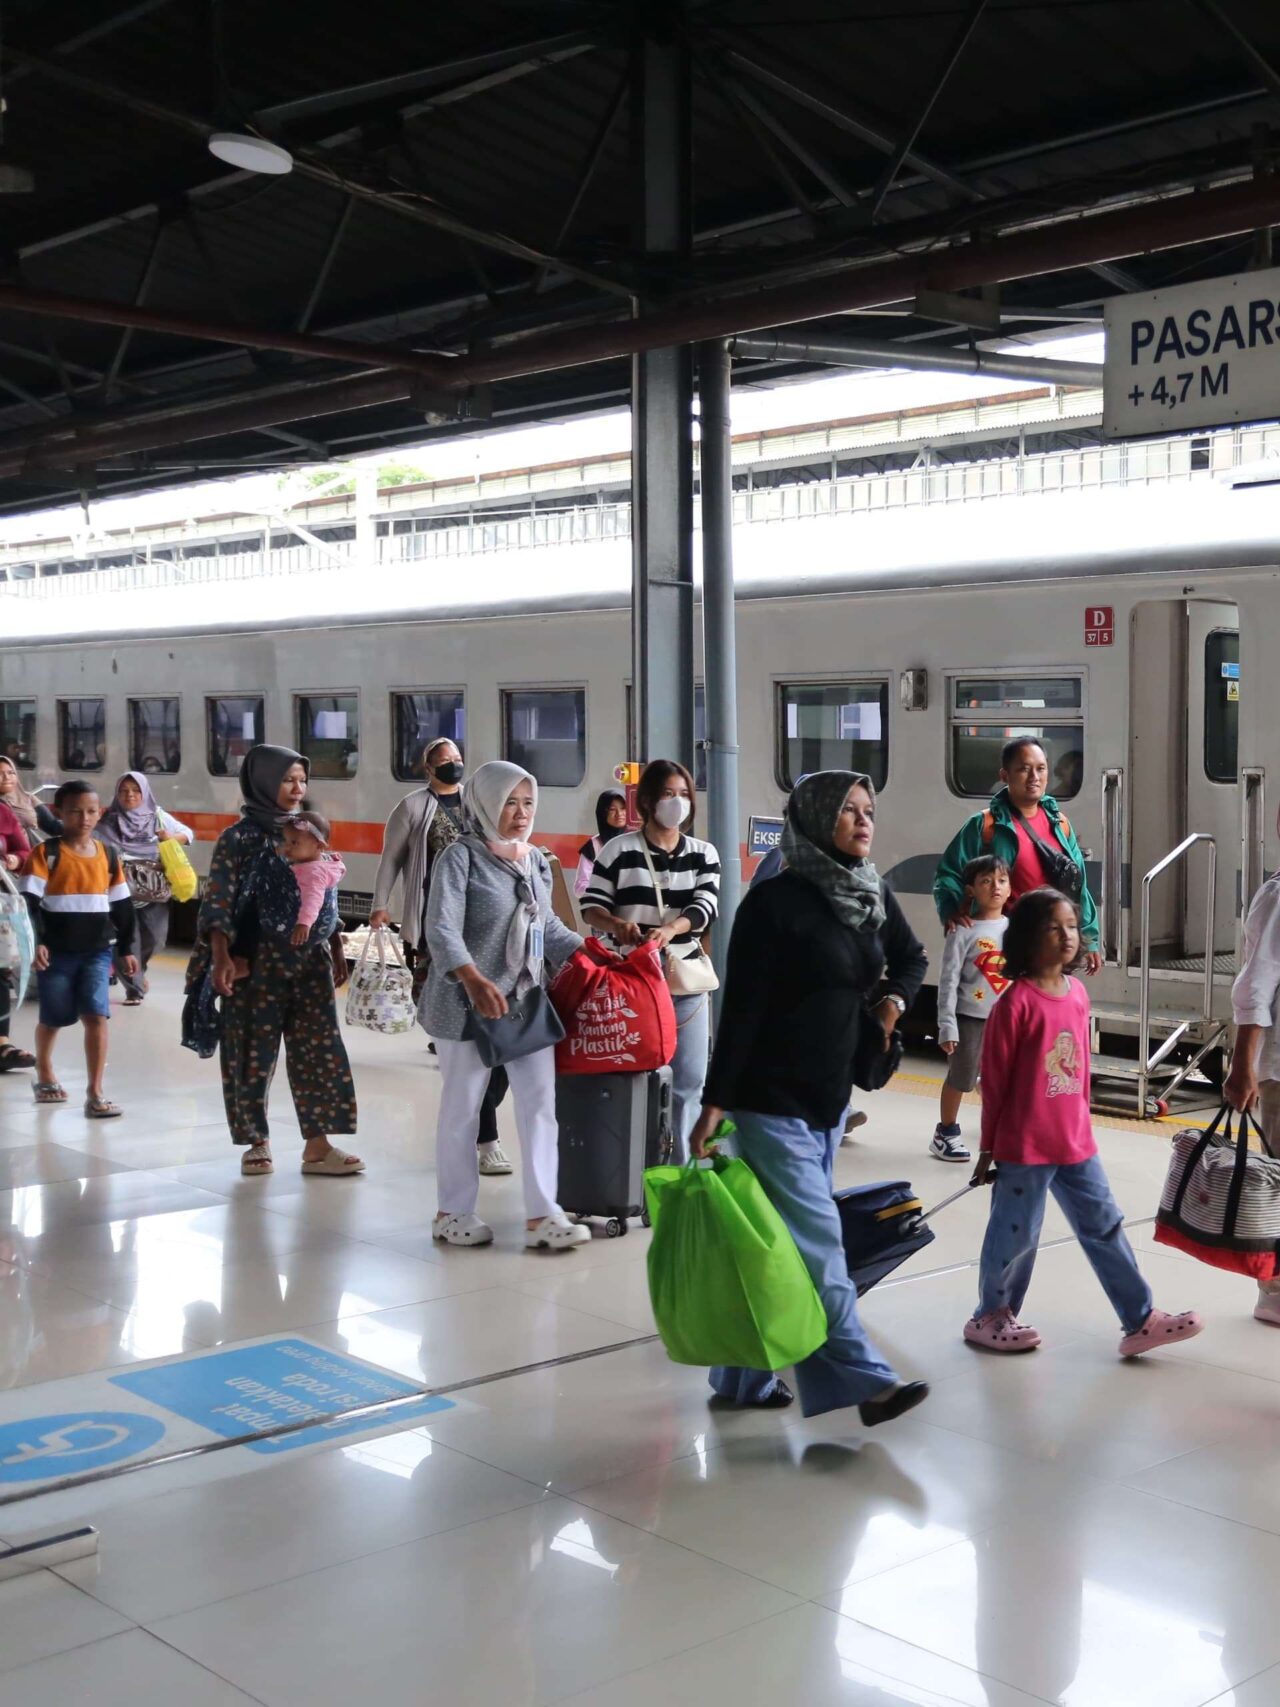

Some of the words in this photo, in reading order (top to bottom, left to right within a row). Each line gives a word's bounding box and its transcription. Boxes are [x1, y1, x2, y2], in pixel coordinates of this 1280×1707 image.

[1200, 362, 1229, 398] M
[1093, 610, 1106, 627] D
[1087, 633, 1097, 643] 37
[1103, 632, 1109, 642] 5
[578, 1020, 627, 1036] Kantong
[570, 1034, 627, 1056] Plastik
[281, 1372, 338, 1396] roda
[210, 1402, 303, 1444] Tmpat
